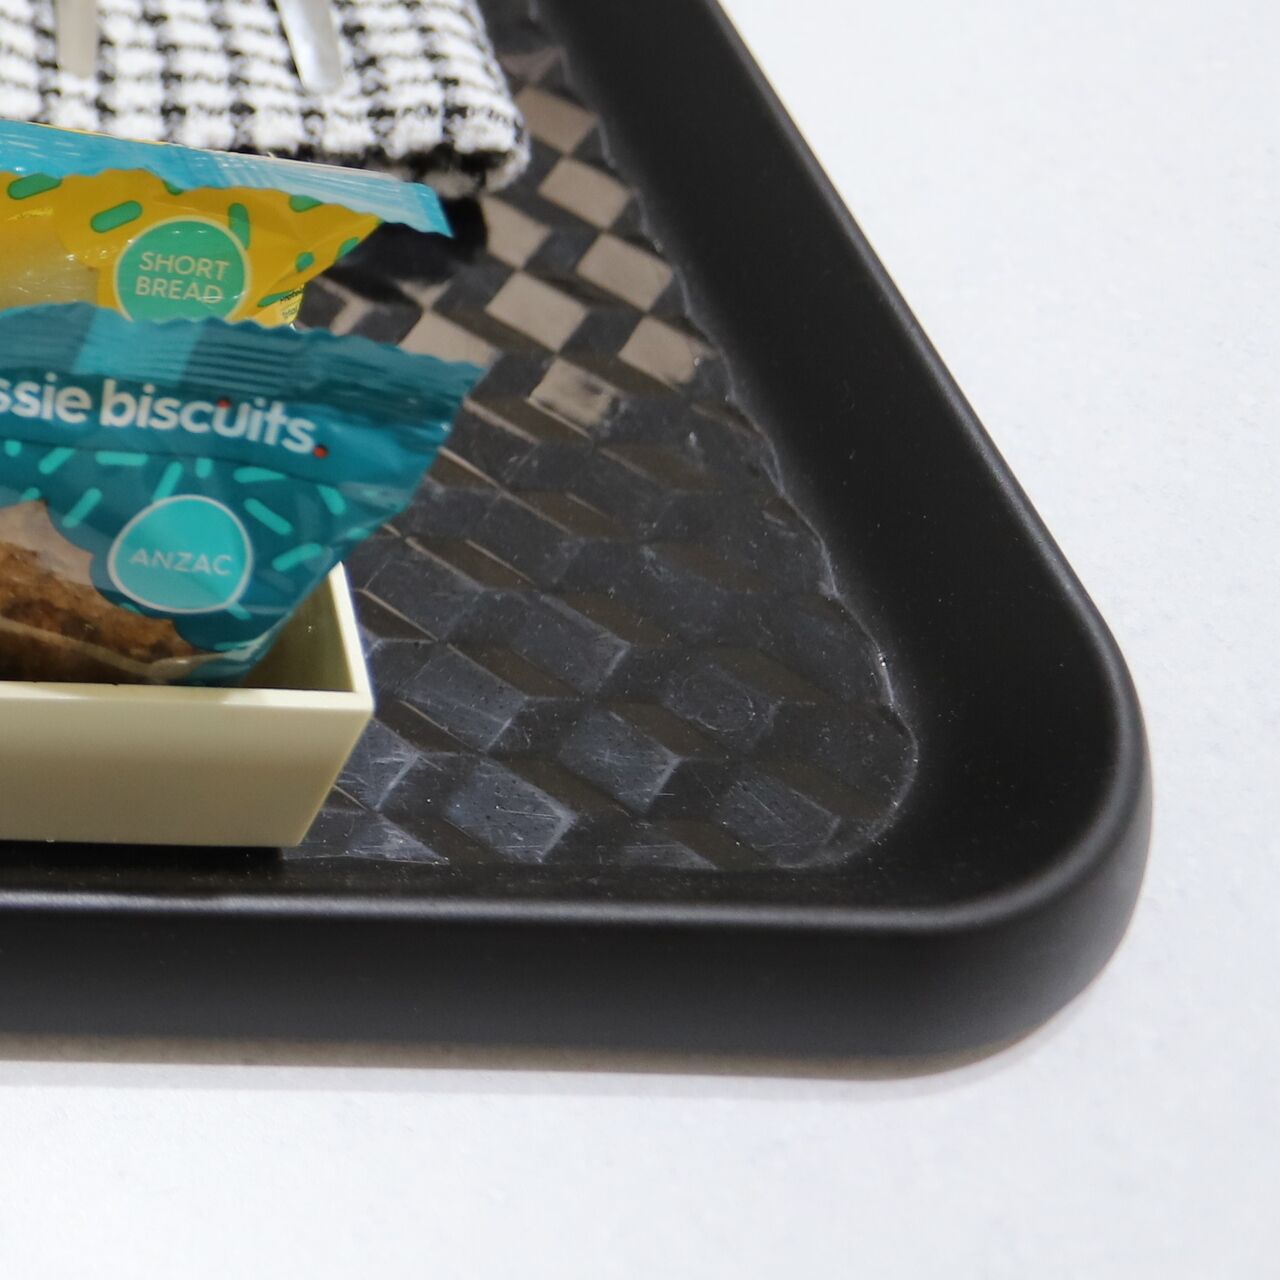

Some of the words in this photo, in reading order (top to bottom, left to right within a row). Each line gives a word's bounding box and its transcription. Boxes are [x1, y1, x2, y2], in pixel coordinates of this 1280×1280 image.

[140, 250, 230, 281] SHORT
[135, 277, 225, 303] BREAD
[128, 549, 233, 577] ANZAC
